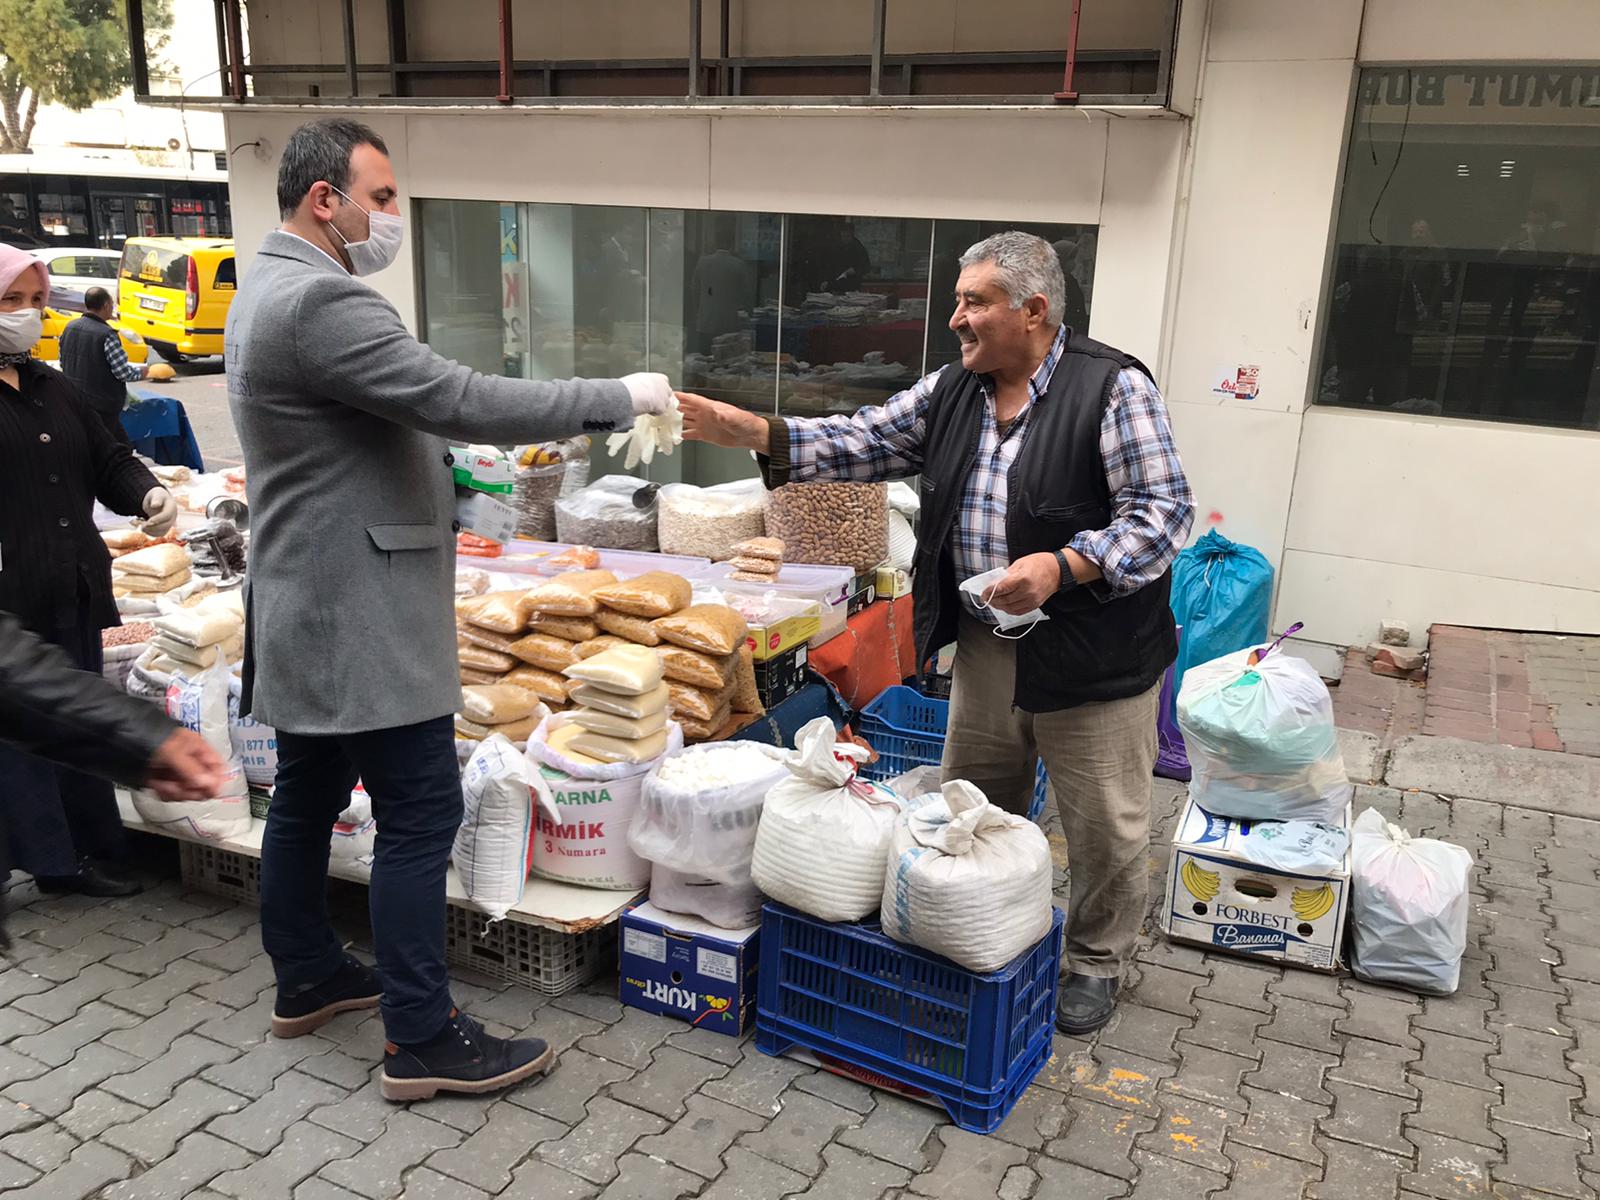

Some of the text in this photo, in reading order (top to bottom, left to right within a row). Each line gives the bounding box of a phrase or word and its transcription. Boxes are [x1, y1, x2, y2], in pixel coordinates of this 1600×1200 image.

[246, 739, 264, 751] 877
[550, 788, 612, 806] ARNA
[545, 840, 606, 857] 3 Numara
[1215, 903, 1292, 930] FORBEST
[1216, 925, 1285, 944] Bananas
[642, 979, 697, 1011] KURT
